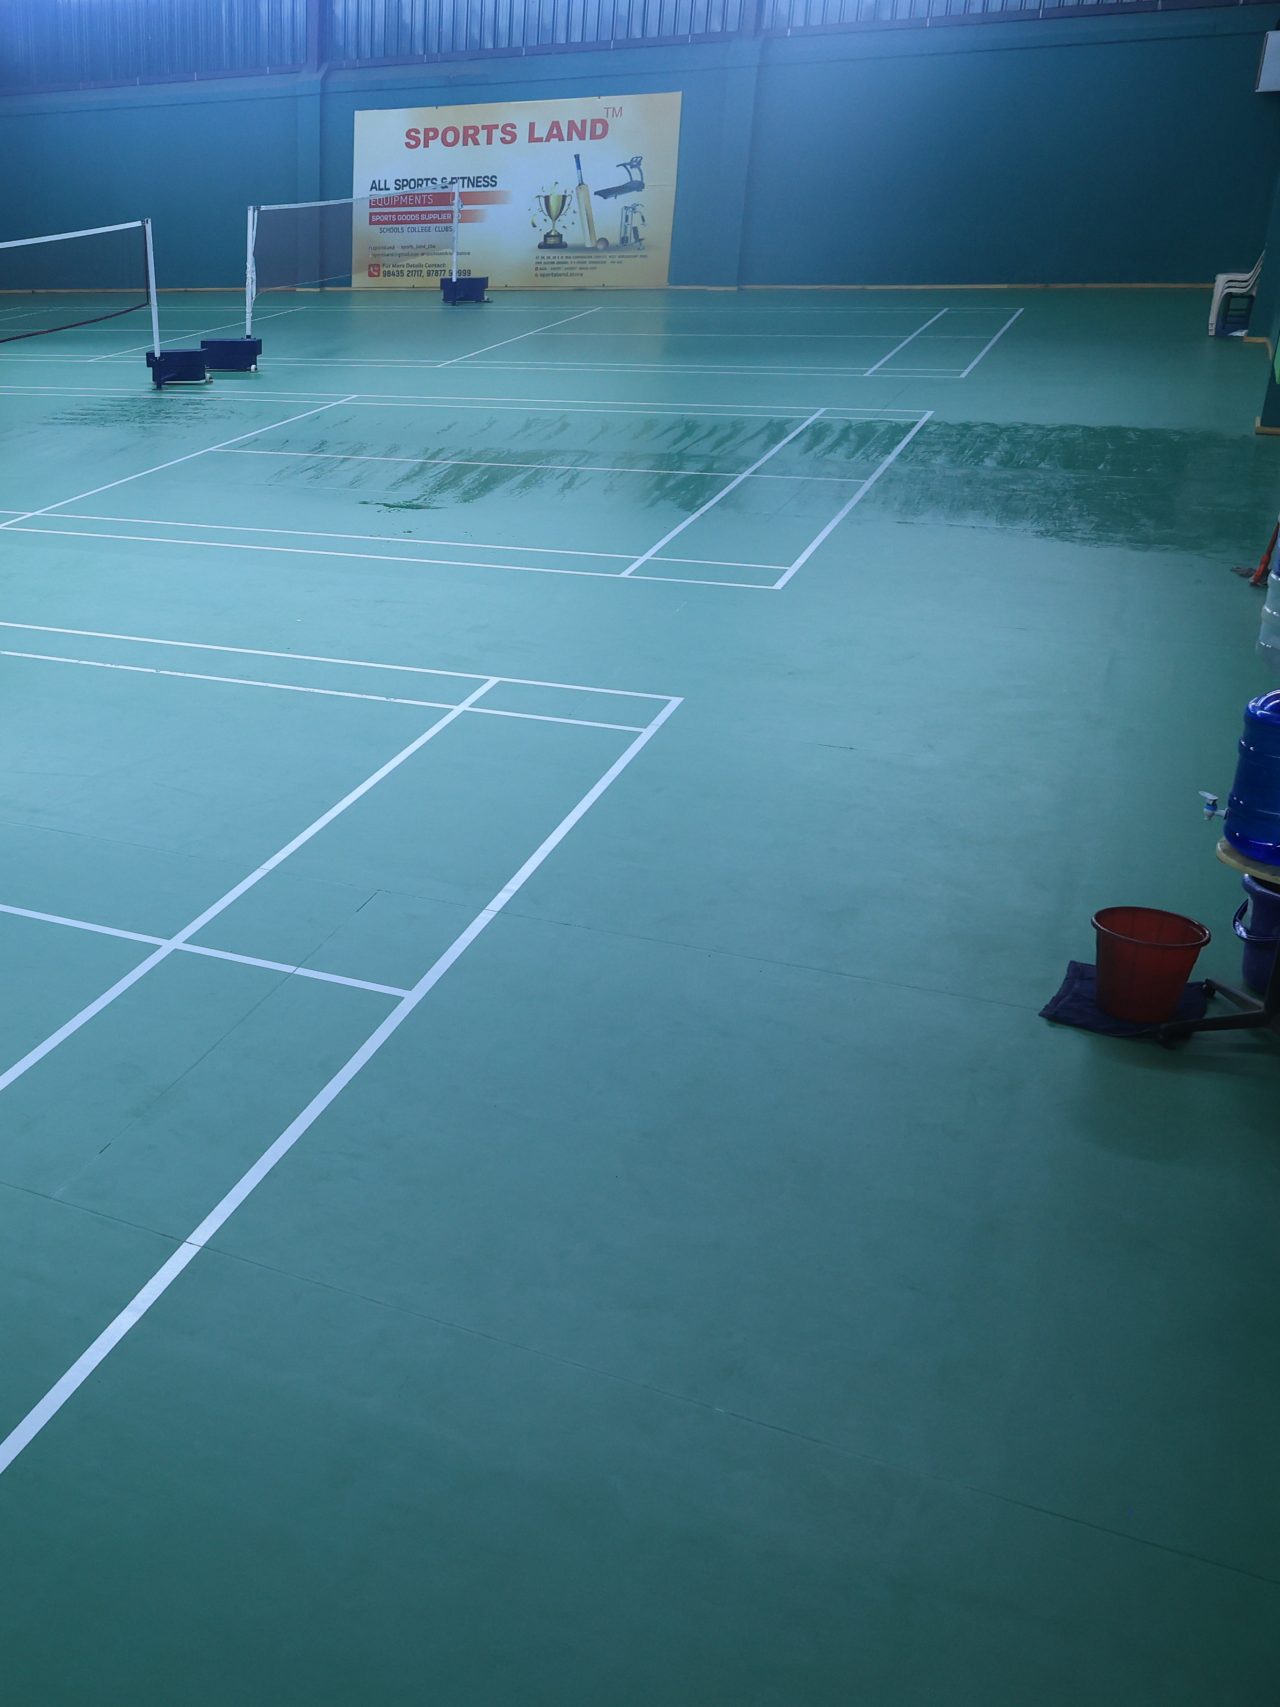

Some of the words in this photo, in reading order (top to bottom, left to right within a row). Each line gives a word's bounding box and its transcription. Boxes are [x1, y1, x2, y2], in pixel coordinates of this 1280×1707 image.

[404, 122, 518, 150] SPORTS
[527, 118, 609, 144] LAND
[369, 179, 390, 191] ALL
[394, 177, 438, 191] SPORTS
[450, 175, 498, 189] FTNESS
[370, 194, 434, 206] EQUIPMENTS
[371, 214, 397, 222] SPORTS
[379, 226, 404, 234] SCHOOLS
